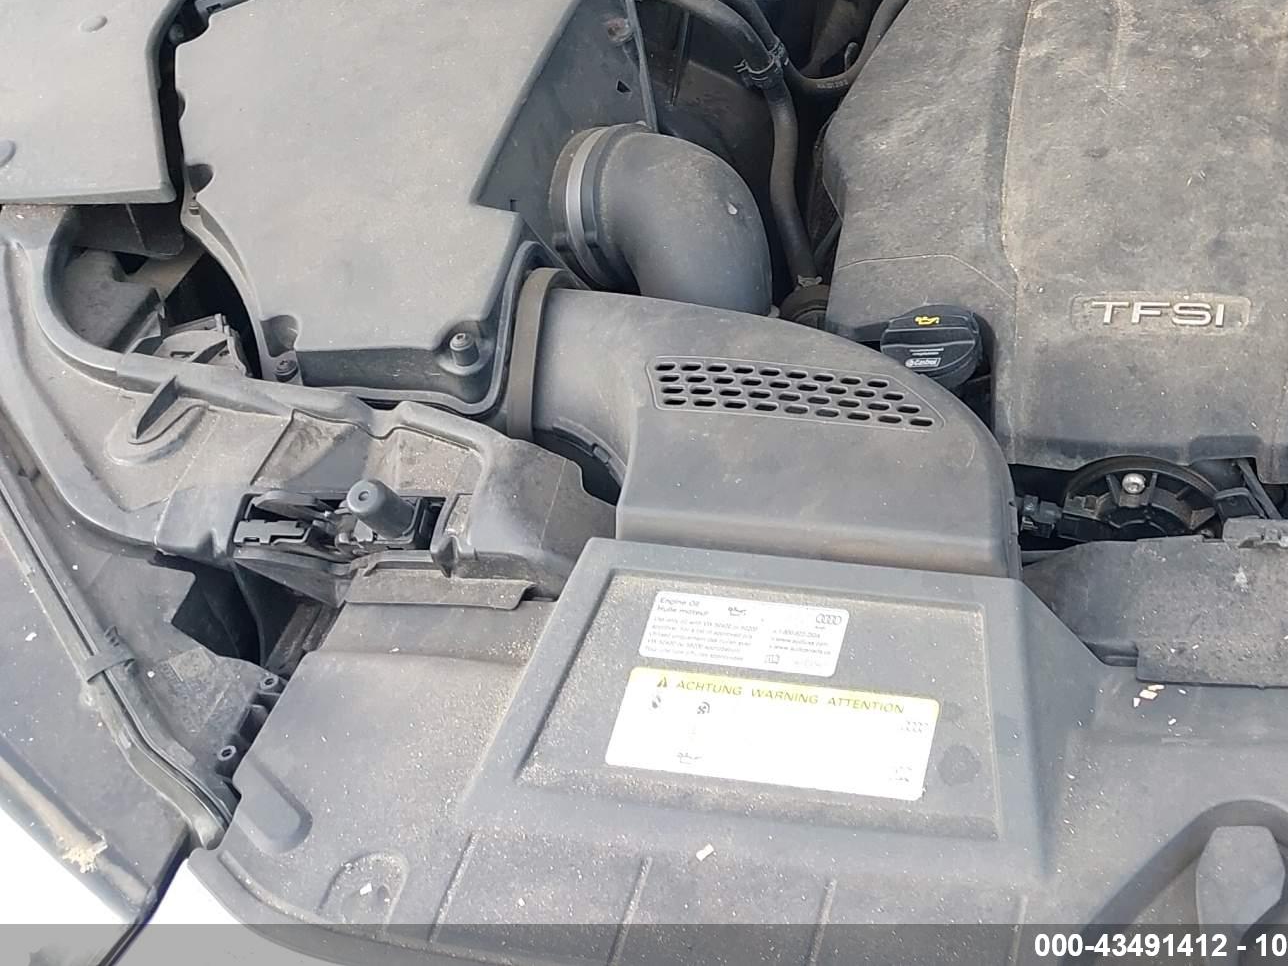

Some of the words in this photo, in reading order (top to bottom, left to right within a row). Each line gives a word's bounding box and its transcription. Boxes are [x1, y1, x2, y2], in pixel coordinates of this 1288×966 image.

[1091, 301, 1225, 327] TFSI
[660, 597, 687, 607] Engine
[676, 679, 742, 696] ACHTUNG
[751, 688, 818, 705] WARNING
[827, 697, 904, 714] ATTENTION
